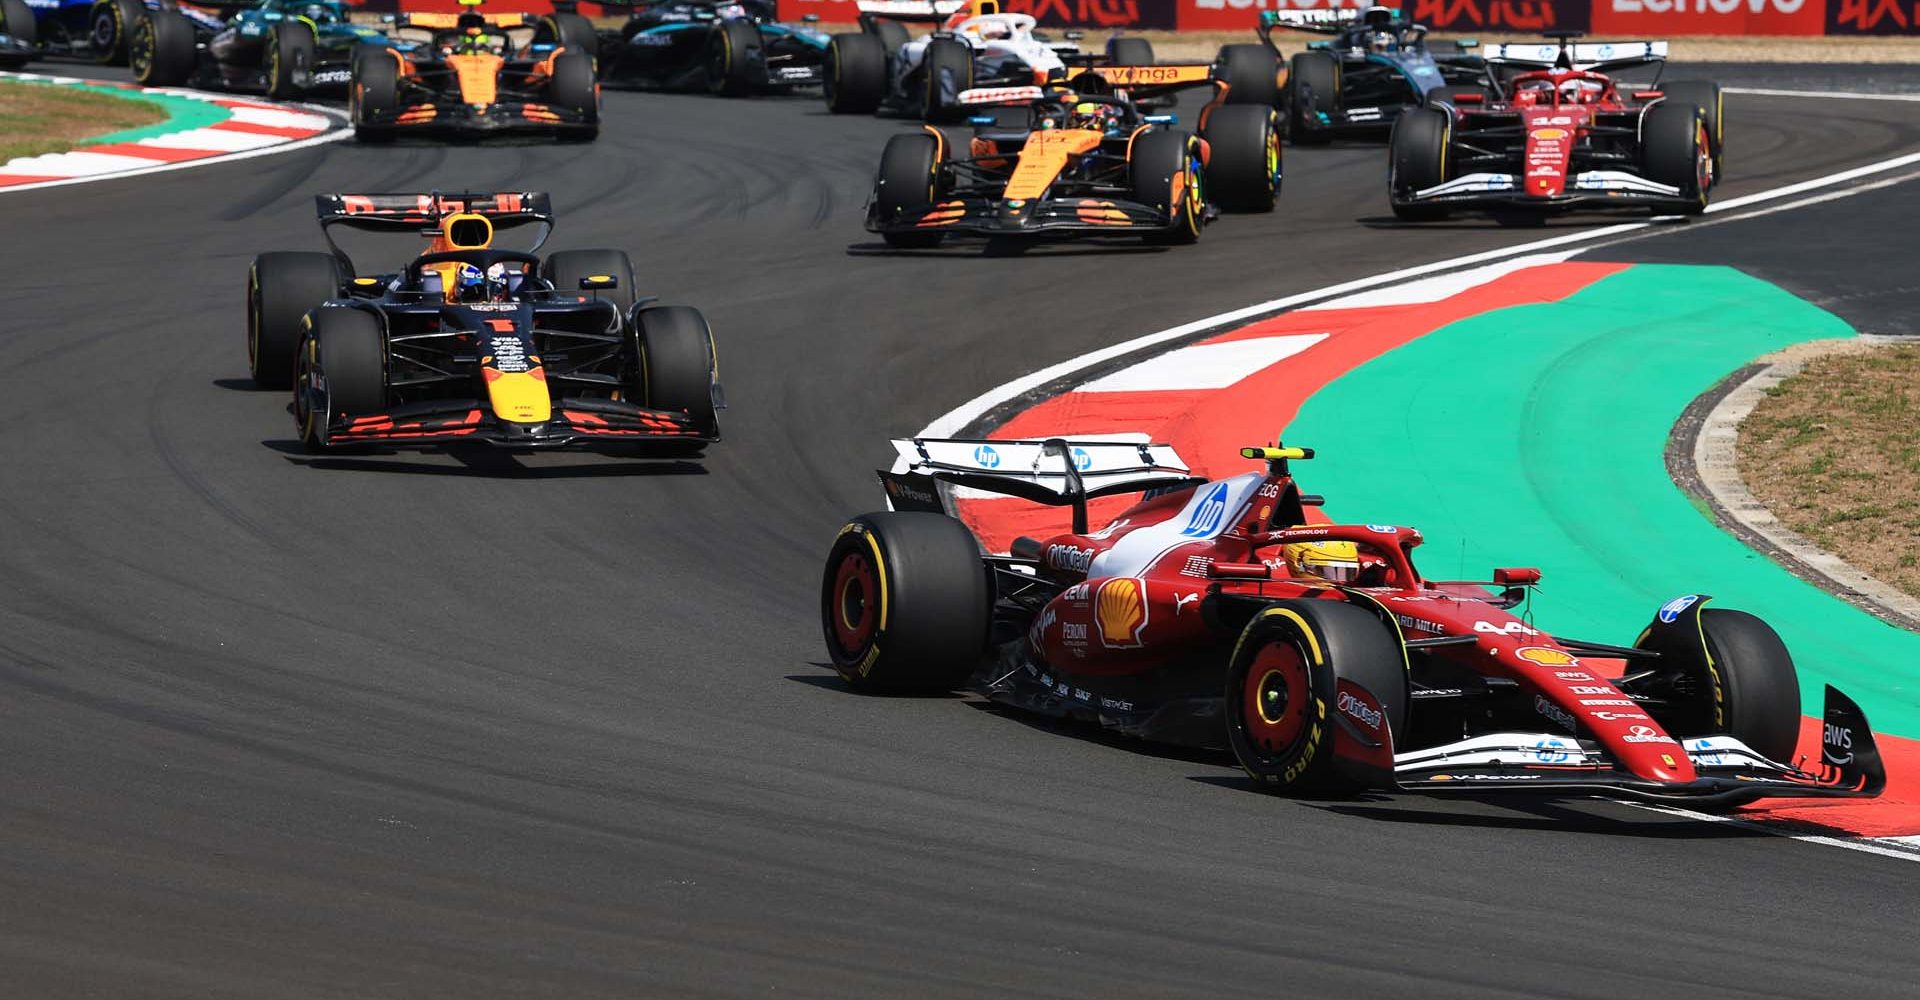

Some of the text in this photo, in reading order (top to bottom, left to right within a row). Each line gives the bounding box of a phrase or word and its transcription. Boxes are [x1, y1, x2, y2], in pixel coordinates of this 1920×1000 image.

[975, 445, 999, 468] hp
[1181, 483, 1227, 537] hp
[1180, 555, 1215, 579] IBM
[1063, 622, 1087, 640] PERONI
[1414, 618, 1445, 635] MILLE
[1474, 620, 1539, 636] 44
[1568, 686, 1617, 695] IBM
[1824, 723, 1852, 750] aws
